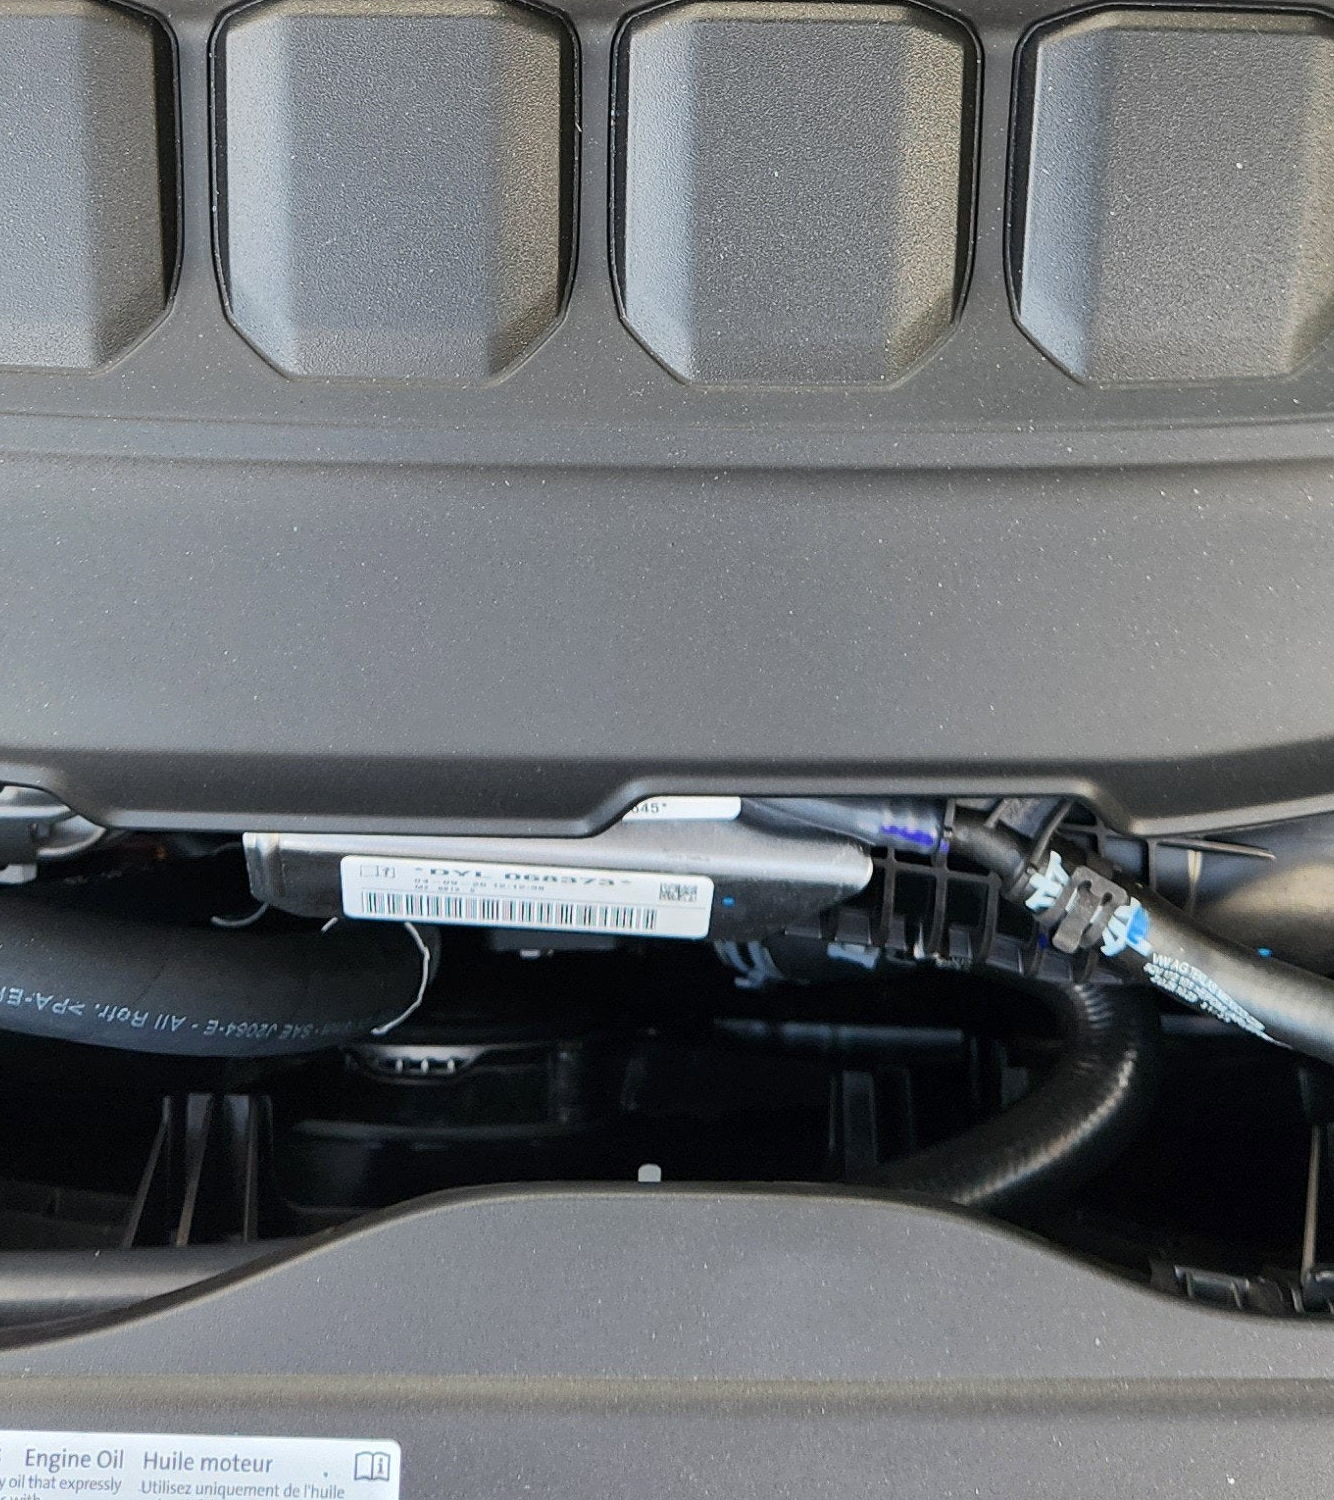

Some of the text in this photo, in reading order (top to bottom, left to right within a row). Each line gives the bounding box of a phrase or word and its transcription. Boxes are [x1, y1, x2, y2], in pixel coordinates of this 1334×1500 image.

[24, 1448, 124, 1473] Engine Oil
[143, 1451, 274, 1474] Huile moteur
[8, 1476, 26, 1489] oil
[28, 1476, 57, 1490] that
[60, 1477, 123, 1493] expressly
[141, 1480, 346, 1499] Utilisez uniquement de l'huile
